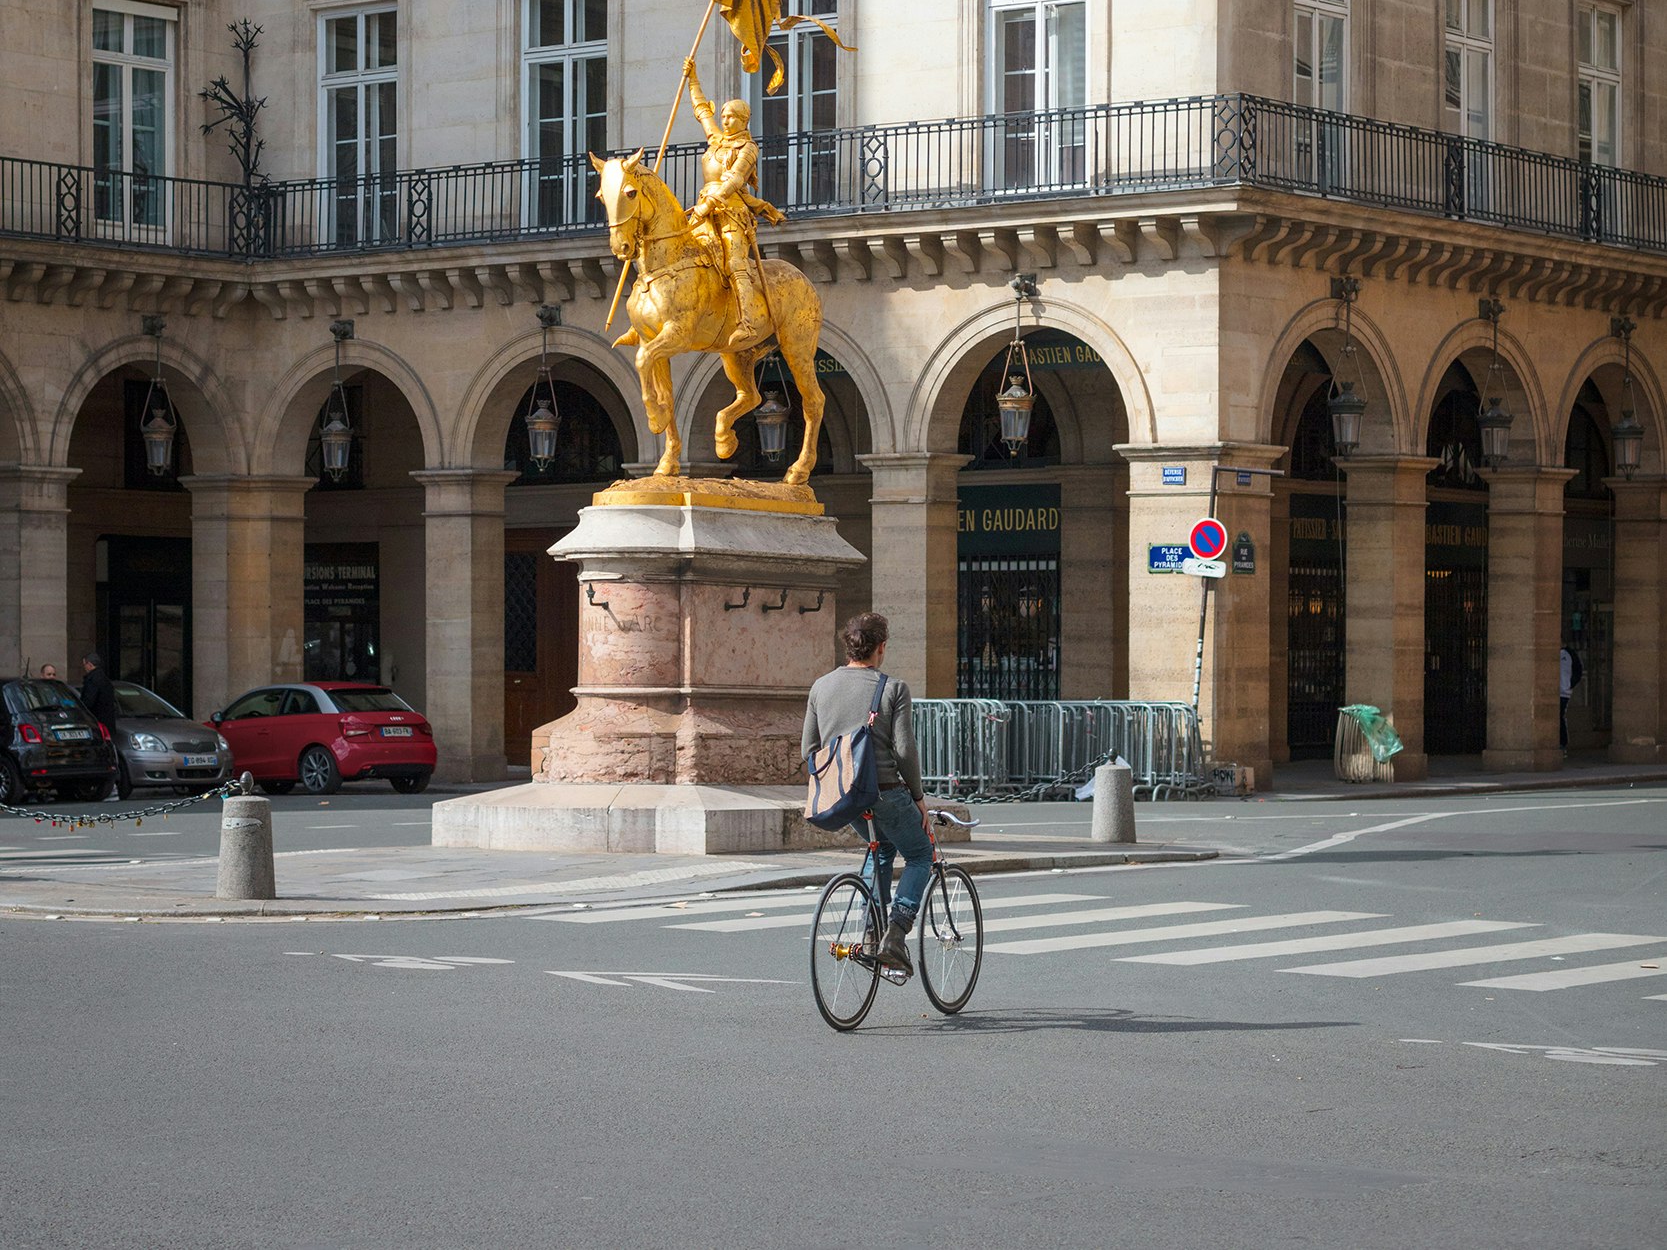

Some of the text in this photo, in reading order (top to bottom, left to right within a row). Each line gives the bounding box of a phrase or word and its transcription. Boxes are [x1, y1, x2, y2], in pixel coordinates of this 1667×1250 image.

[957, 508, 1058, 531] EN GAUDARD
[1161, 547, 1183, 555] PLACE
[1166, 554, 1179, 562] DES
[338, 565, 375, 579] TERMINAL
